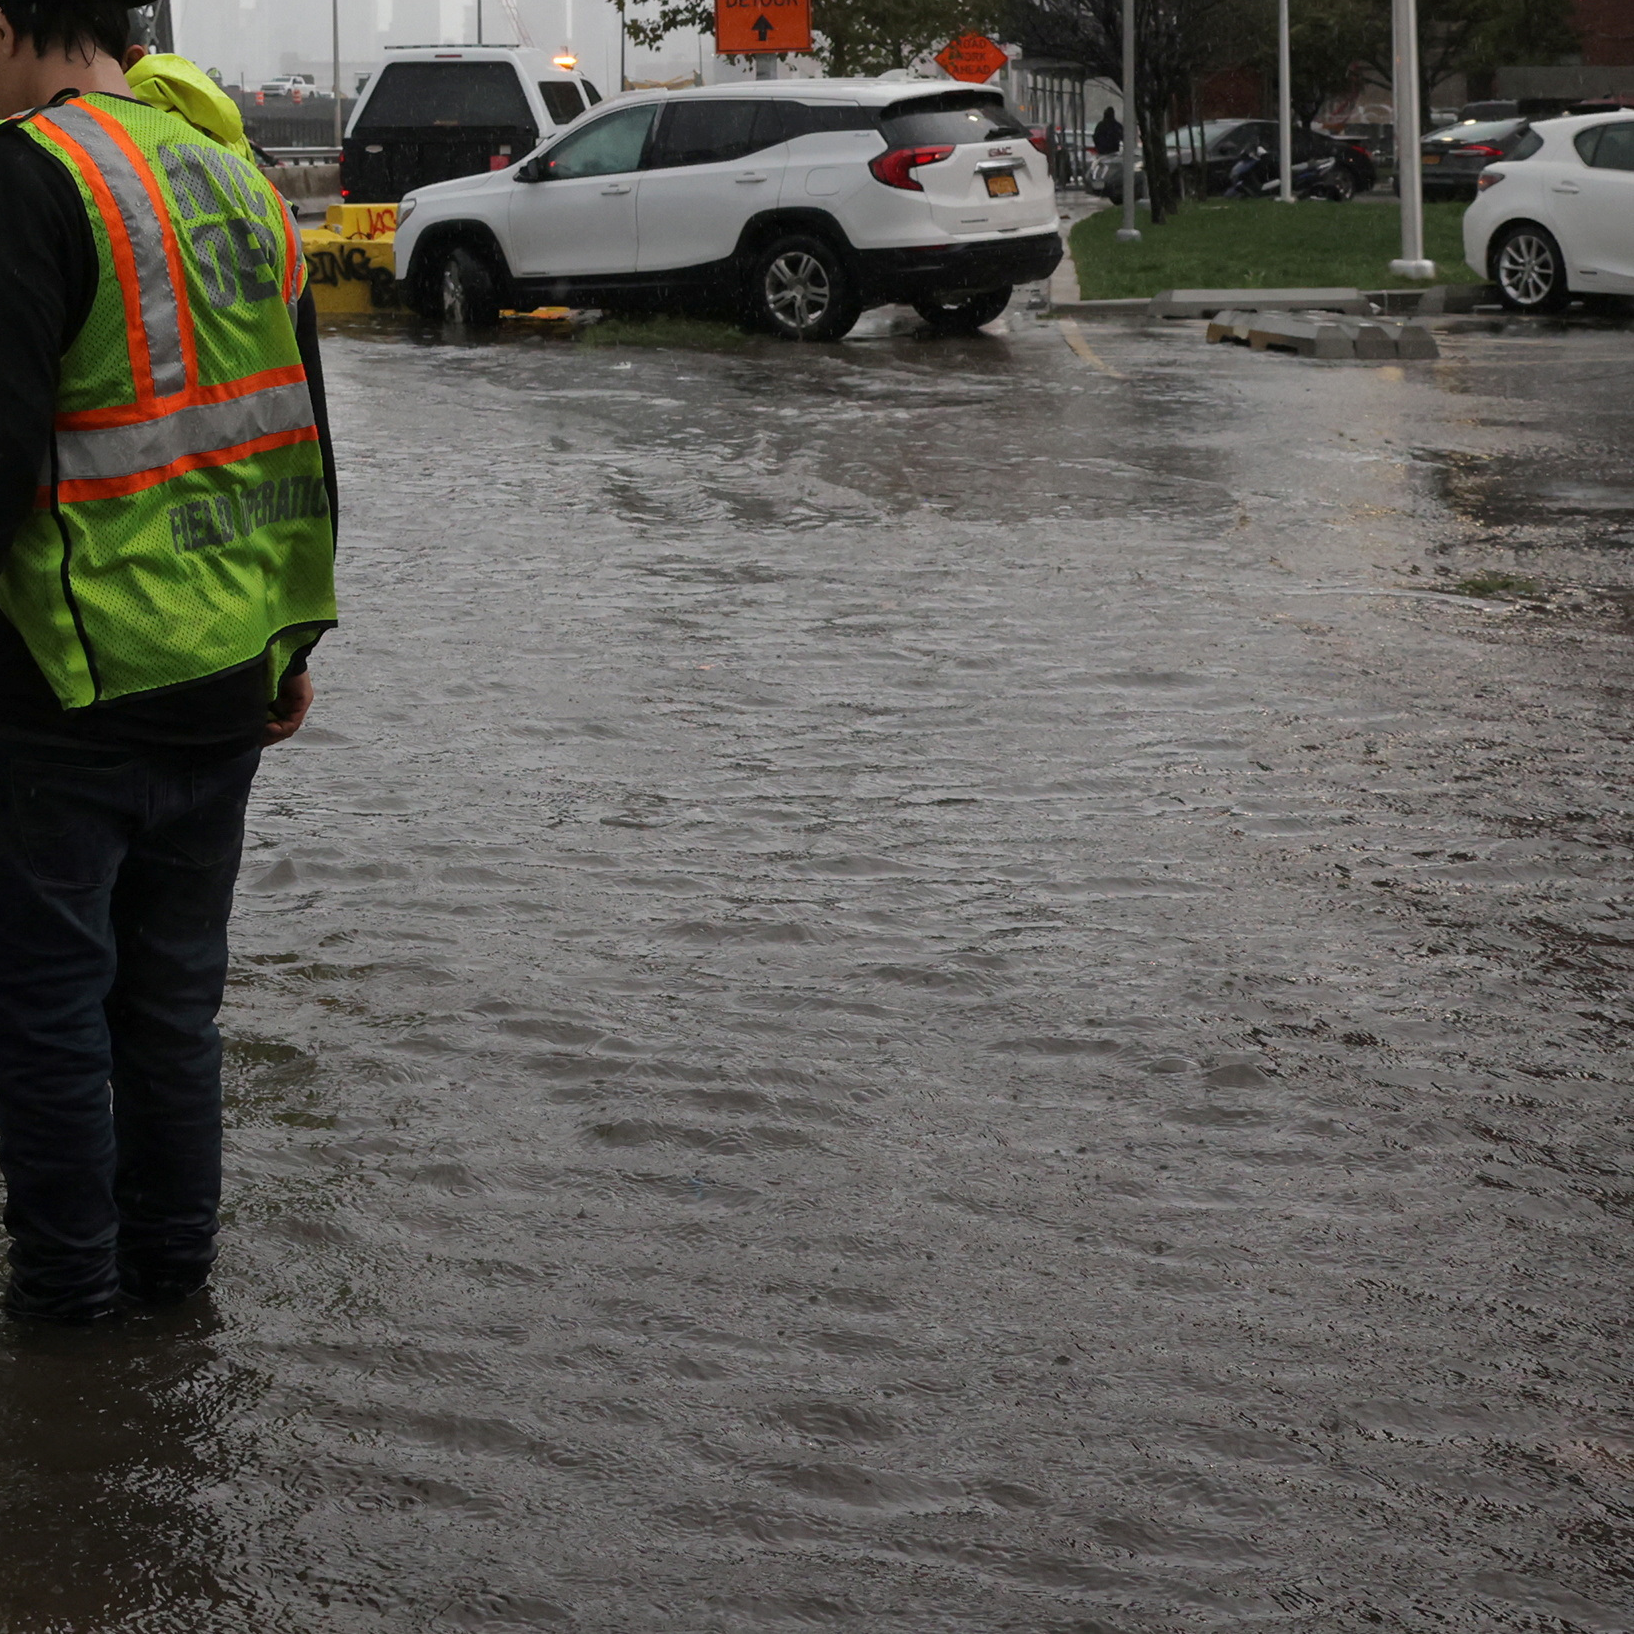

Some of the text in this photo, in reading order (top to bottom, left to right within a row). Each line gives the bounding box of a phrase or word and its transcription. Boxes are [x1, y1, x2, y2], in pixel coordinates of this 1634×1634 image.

[157, 143, 268, 220] NYC
[188, 217, 281, 309] DEP
[168, 495, 235, 555] FIELD
